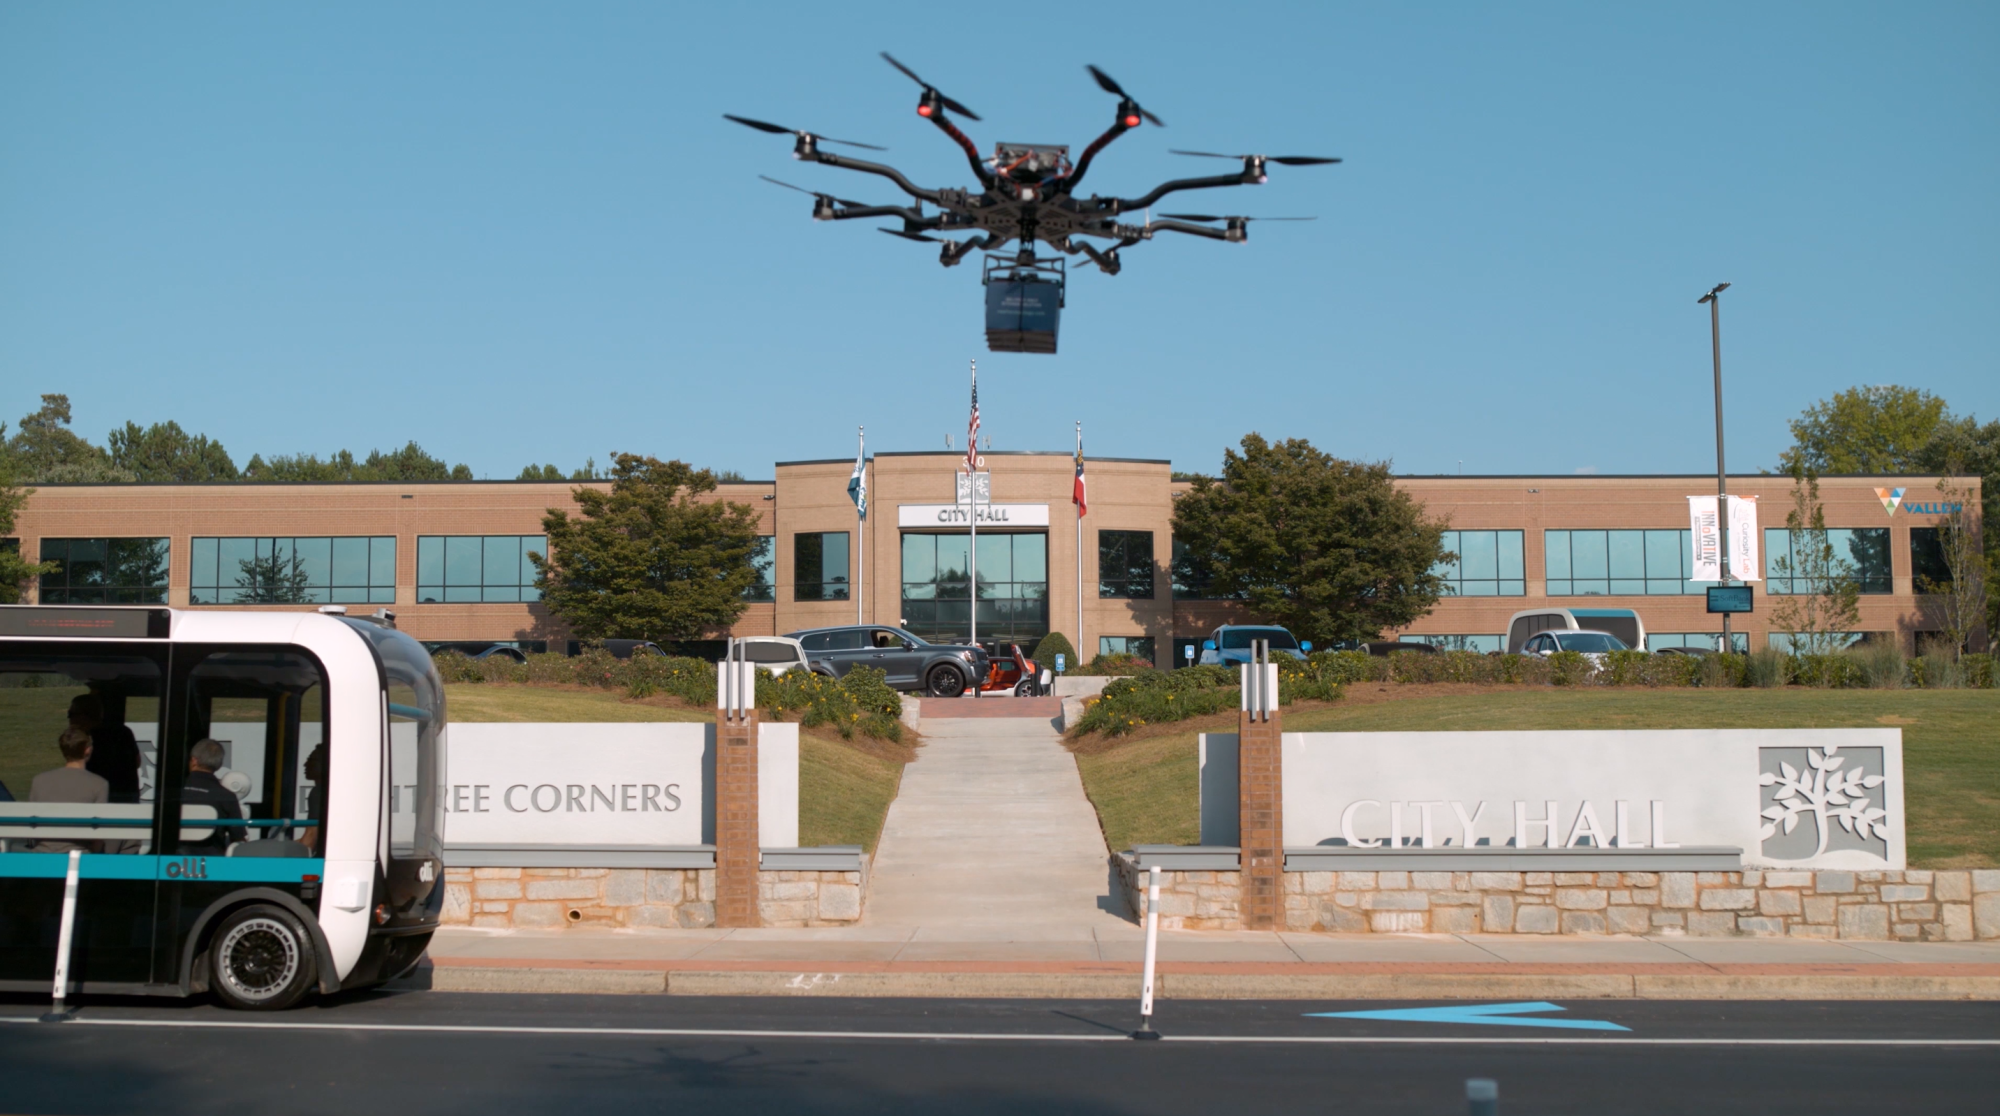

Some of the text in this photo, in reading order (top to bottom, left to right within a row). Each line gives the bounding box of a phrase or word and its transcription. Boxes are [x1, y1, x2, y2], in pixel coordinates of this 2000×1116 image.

[937, 509, 1009, 522] CITY HALL
[1742, 522, 1750, 574] Curiosity Lab
[1720, 594, 1750, 602] SoftBank
[503, 783, 682, 813] CORNERS
[1340, 799, 1681, 849] CITY HALL
[166, 857, 207, 878] olli
